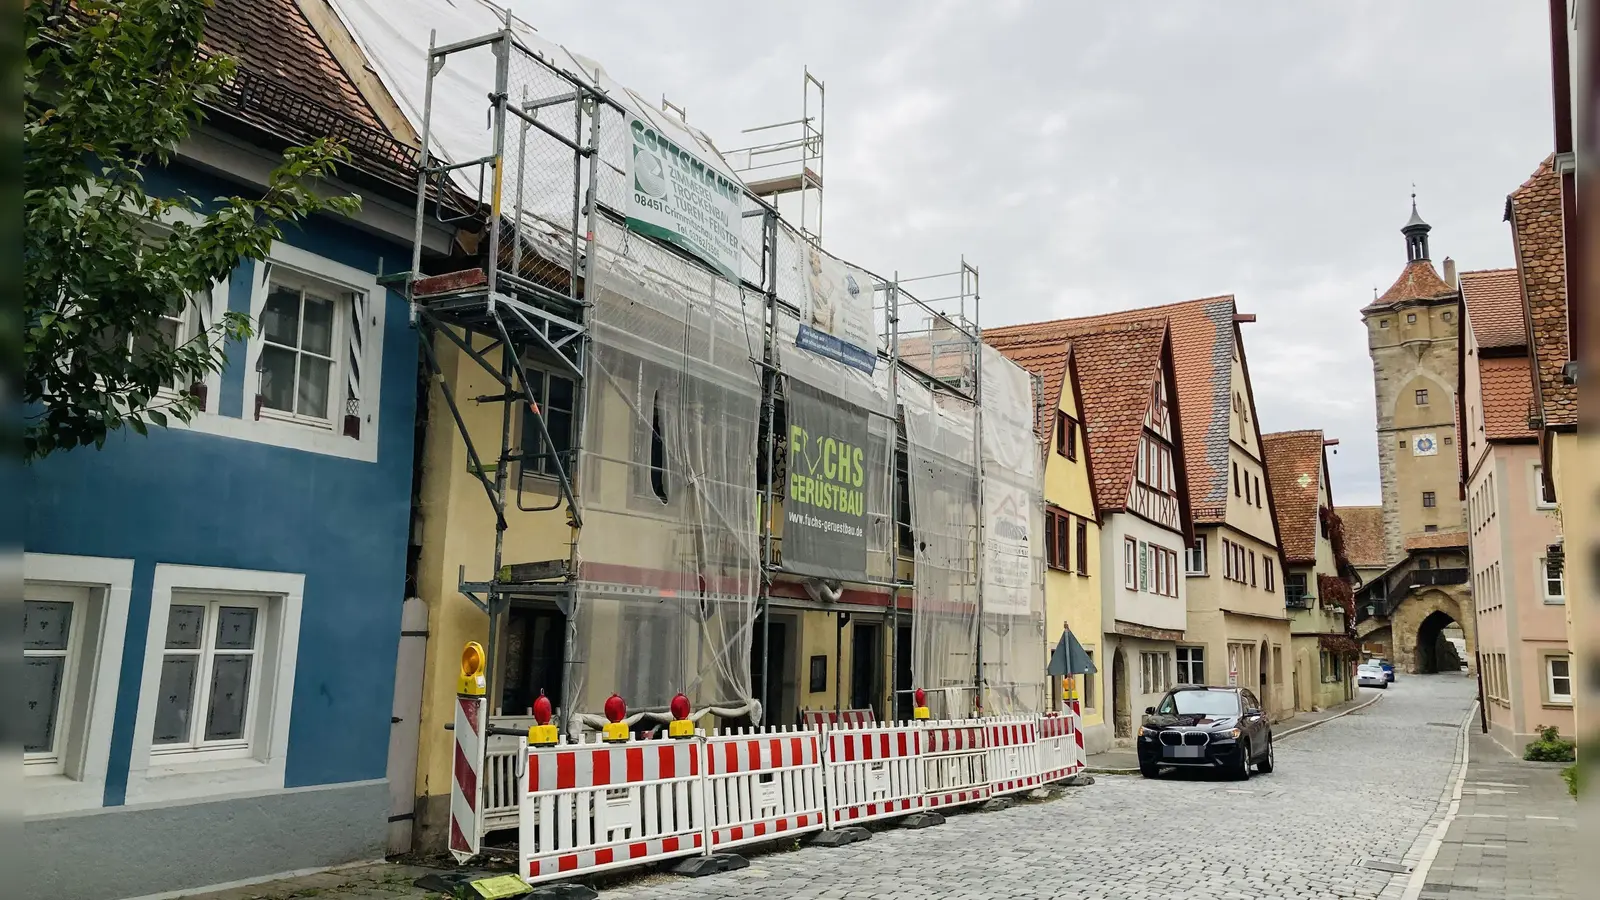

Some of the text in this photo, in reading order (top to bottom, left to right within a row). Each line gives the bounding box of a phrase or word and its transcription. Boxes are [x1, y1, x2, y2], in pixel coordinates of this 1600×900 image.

[634, 193, 663, 213] 08451
[667, 165, 713, 204] ZIMMEREI
[671, 179, 729, 227] TROCKENBAU
[790, 472, 863, 517] GERÜSTBAU
[788, 511, 863, 537] www.fuchs-geruestbau.de
